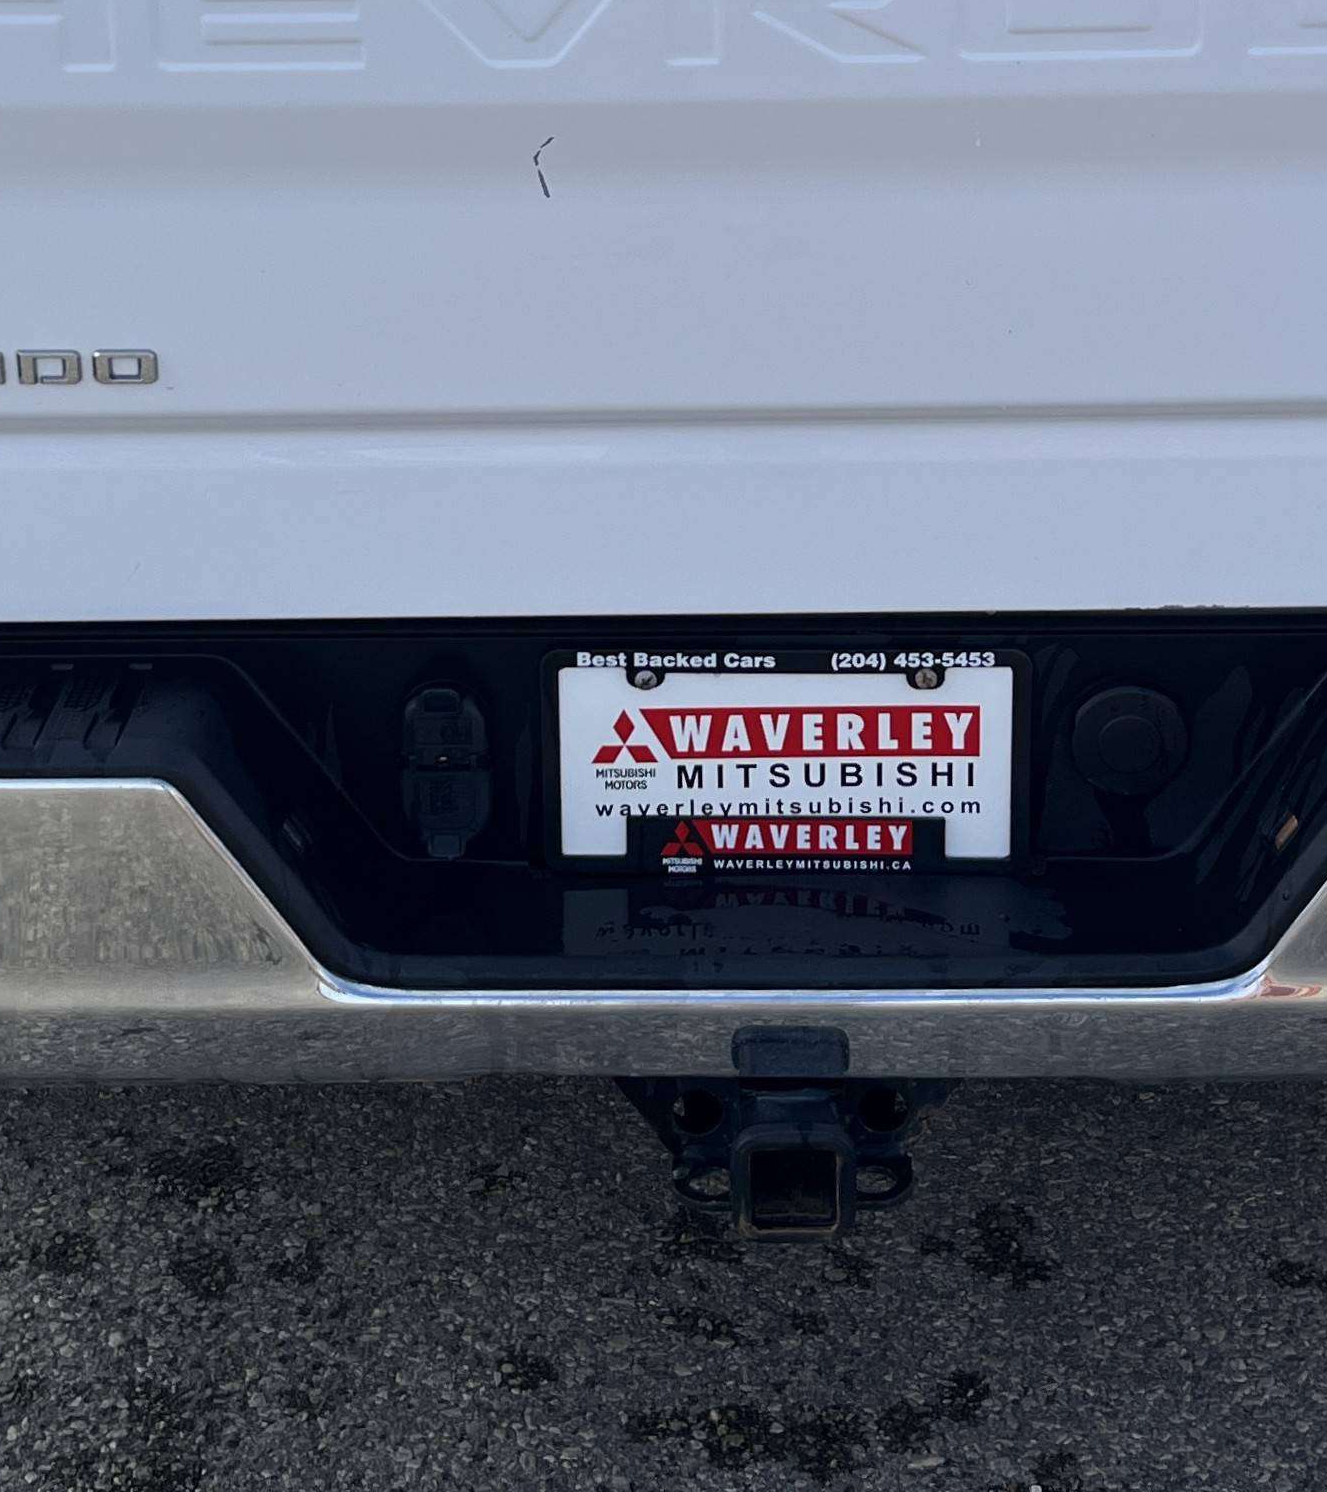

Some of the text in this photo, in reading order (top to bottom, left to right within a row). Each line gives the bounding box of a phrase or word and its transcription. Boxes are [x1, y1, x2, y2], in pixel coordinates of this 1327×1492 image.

[577, 652, 776, 668] Best Backed Cars
[831, 652, 995, 671] (204) 453-5453
[669, 712, 974, 753] WAVERLEY
[596, 768, 656, 778] MITSUBISHI
[677, 762, 974, 789] MITSUBISHI
[605, 781, 648, 790] MOTORS
[596, 797, 981, 817] waverleymitsubishi.com
[710, 824, 908, 850] WAVERLEY
[714, 859, 912, 870] WAVERLEYMITSUBISHI.CA
